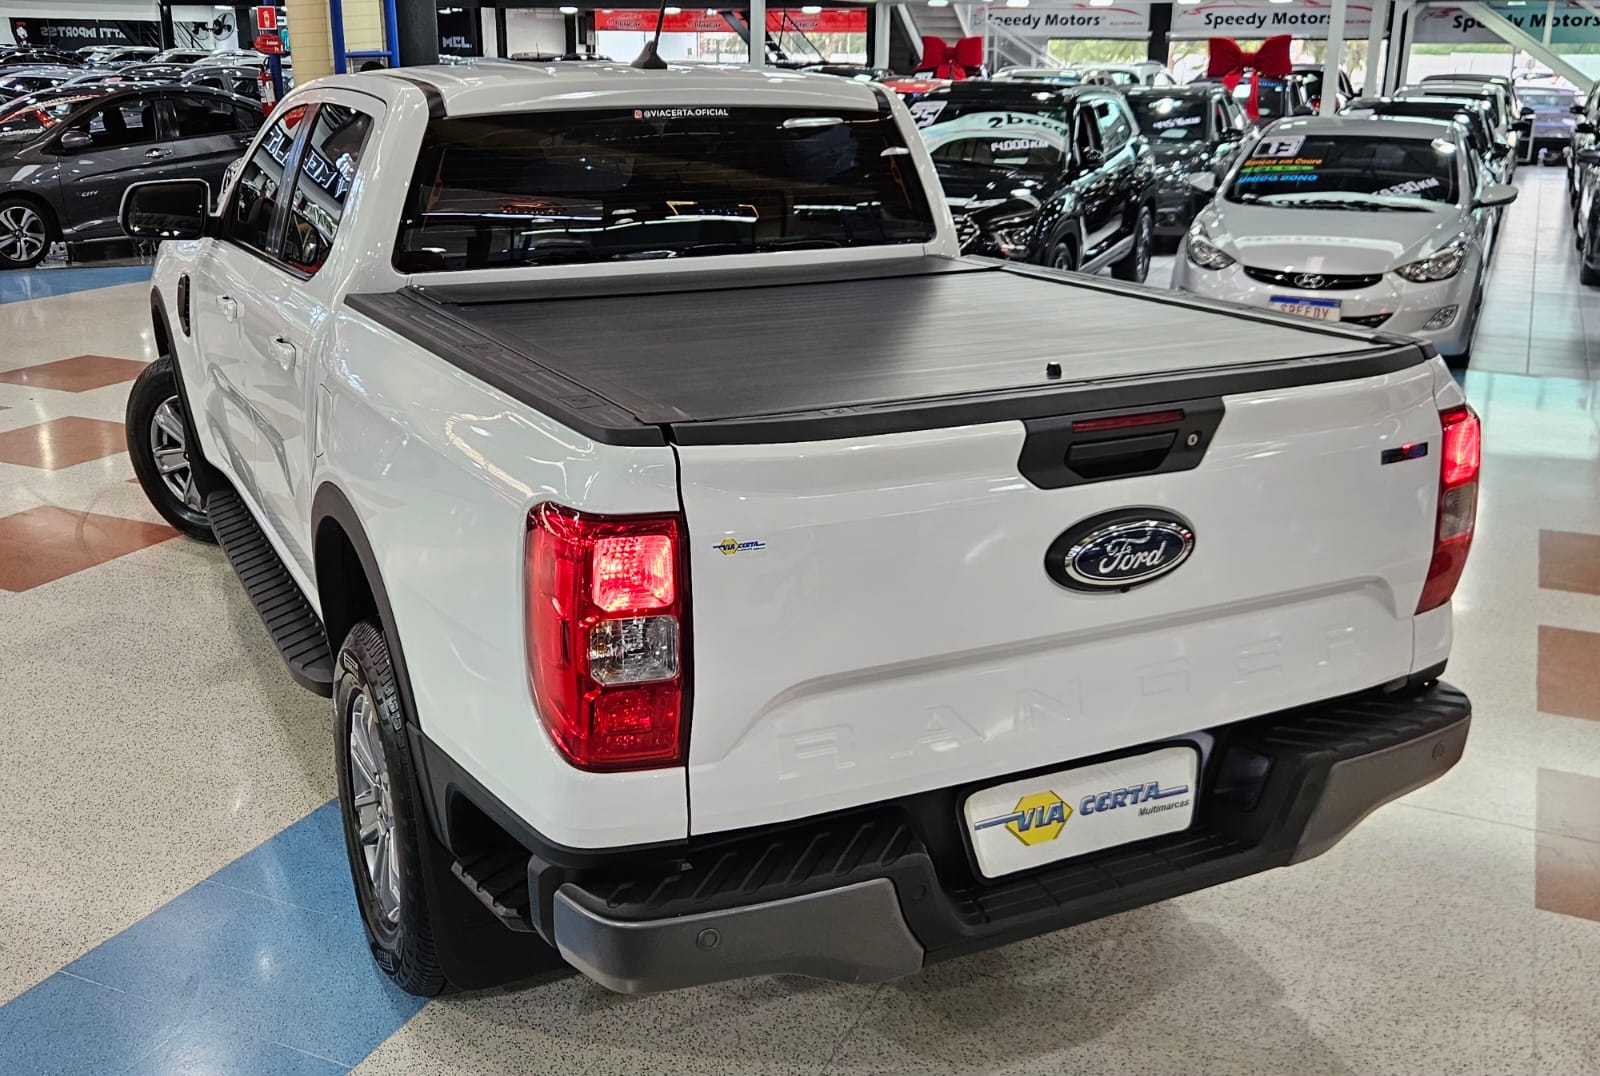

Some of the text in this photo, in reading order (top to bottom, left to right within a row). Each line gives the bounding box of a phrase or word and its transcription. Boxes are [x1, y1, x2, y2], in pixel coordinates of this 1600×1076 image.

[1045, 14, 1100, 26] Motors
[1204, 13, 1267, 28] Speedy
[644, 109, 728, 118] @VIACERTA.OFICIAL
[1098, 531, 1167, 574] Ford
[1014, 781, 1160, 832] VIA CERTA
[1138, 799, 1190, 817] Multimarcas
